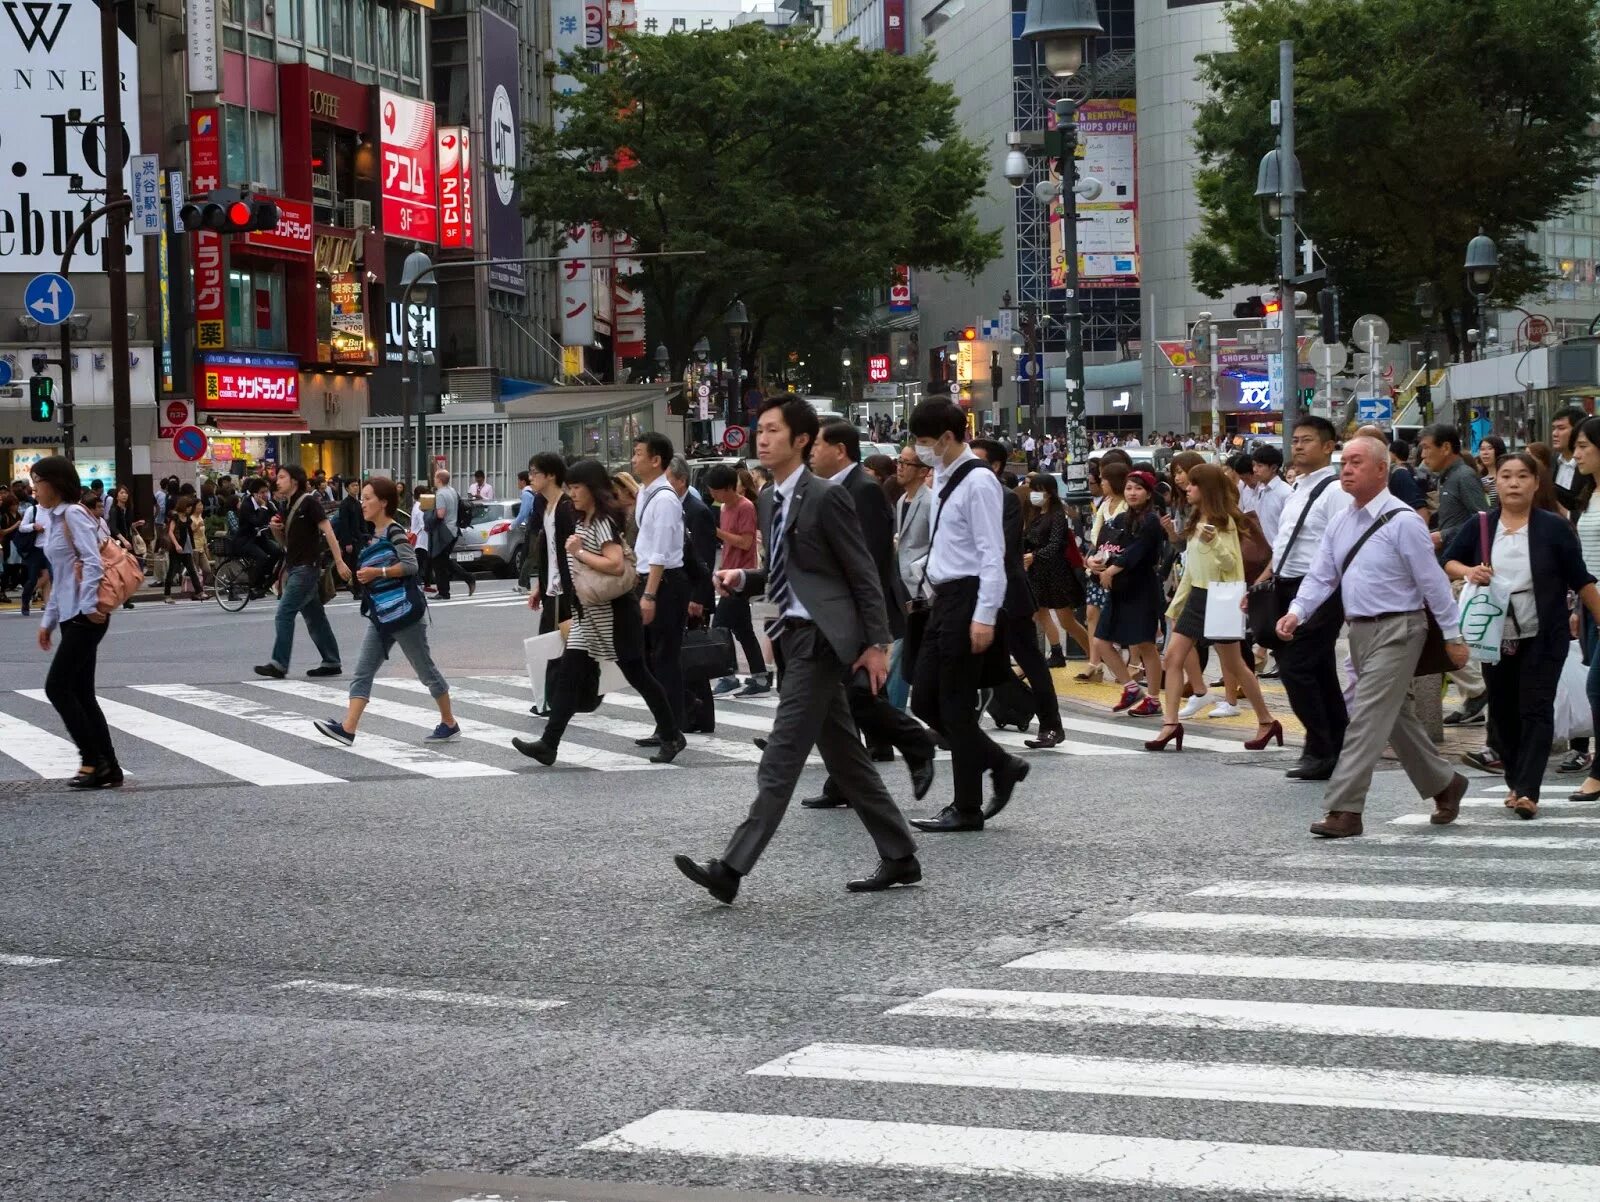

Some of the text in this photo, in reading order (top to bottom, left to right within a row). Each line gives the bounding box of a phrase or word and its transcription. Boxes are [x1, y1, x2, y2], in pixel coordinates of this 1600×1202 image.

[386, 151, 425, 195] アコム
[142, 161, 158, 227] 渋谷駅前
[443, 178, 459, 223] アコム
[400, 207, 413, 231] 3F
[446, 228, 457, 237] 3F
[332, 274, 344, 282] 2F
[200, 322, 221, 345] 薬
[871, 359, 885, 368] UNI
[871, 369, 887, 379] QLO
[238, 376, 286, 399] サンドラッグ
